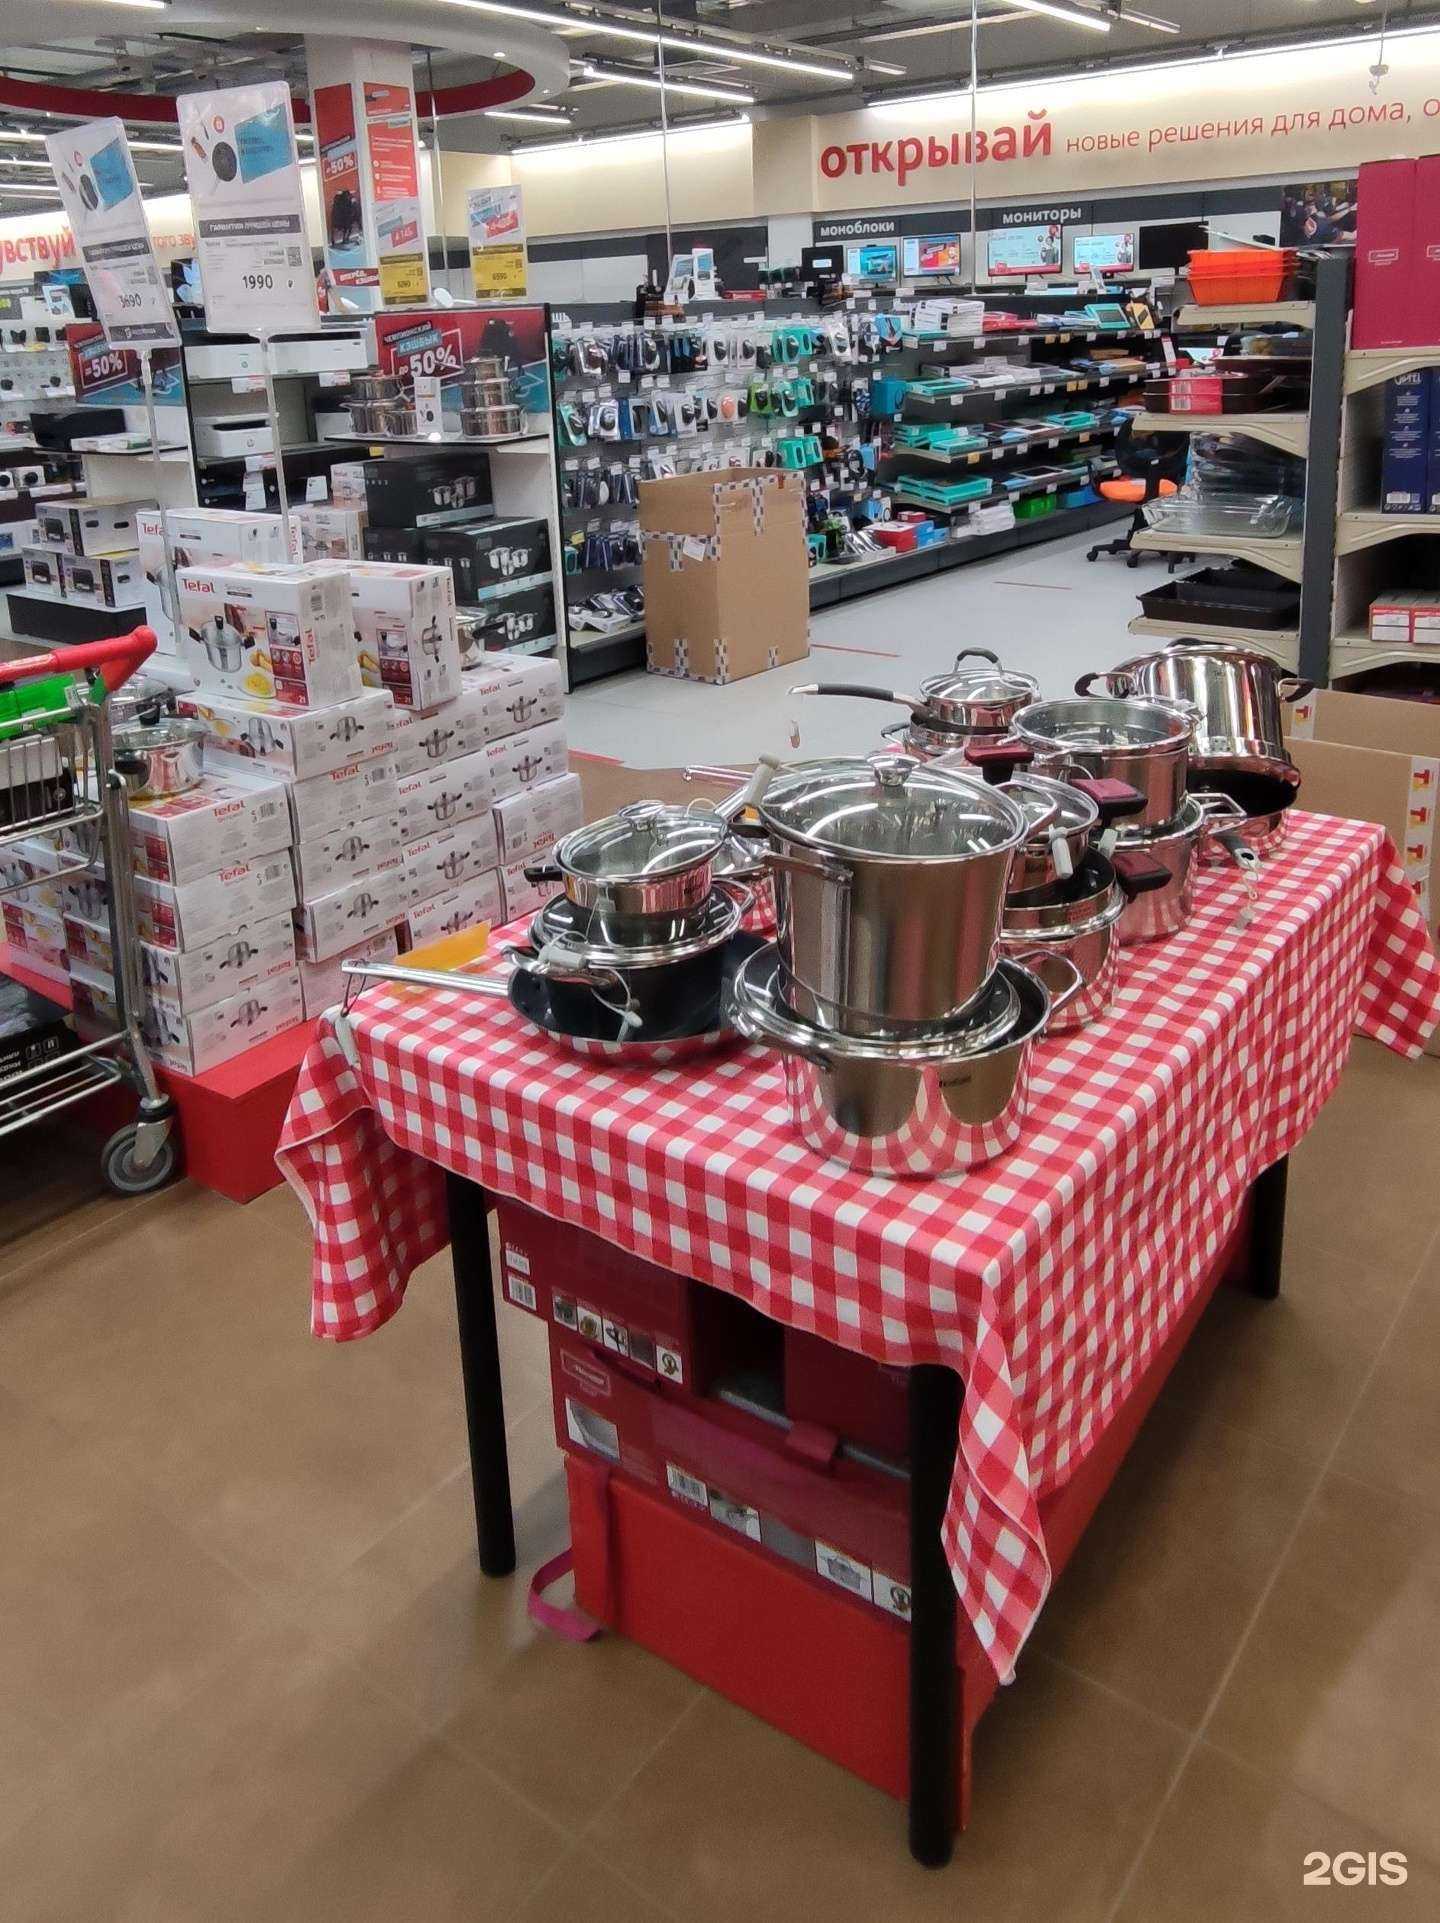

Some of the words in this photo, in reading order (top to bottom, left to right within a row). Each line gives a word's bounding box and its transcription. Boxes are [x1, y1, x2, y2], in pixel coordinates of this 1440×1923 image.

[1066, 130, 1140, 153] новые
[1149, 115, 1263, 152] решения
[1270, 110, 1321, 137] для
[1328, 100, 1413, 131] дома,
[820, 109, 1051, 187] открывай
[1002, 207, 1082, 225] мониторы
[821, 221, 895, 237] моноблоки
[242, 275, 273, 289] 1990
[142, 522, 167, 536] Tefa
[182, 578, 215, 593] Tefal
[480, 684, 501, 696] Tefal
[486, 745, 508, 758] Tefal
[329, 764, 361, 782] Tefal
[399, 780, 423, 796] Tefal
[213, 800, 246, 817] Tefal
[407, 841, 431, 857] Tefal
[218, 863, 251, 882] Tefal
[412, 903, 436, 919] Tefal
